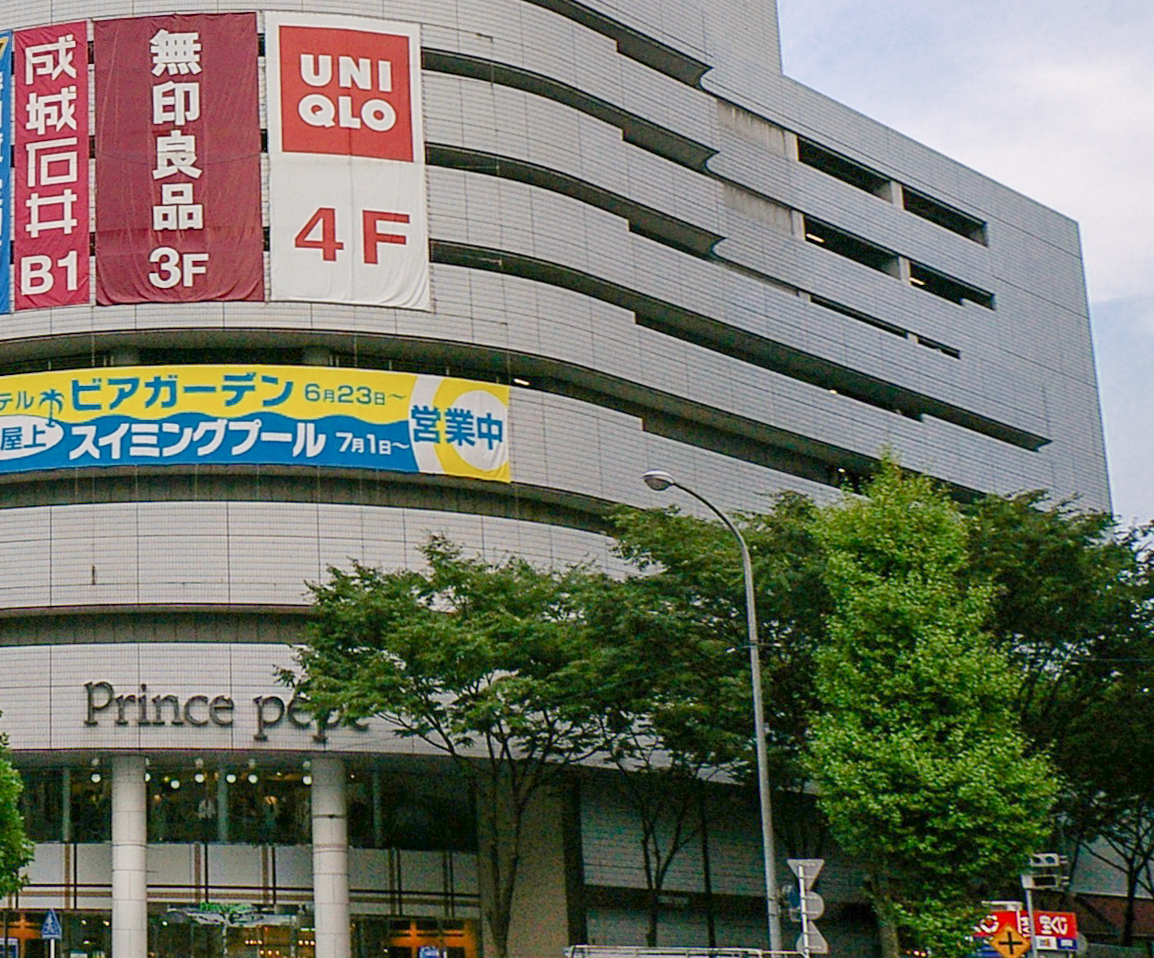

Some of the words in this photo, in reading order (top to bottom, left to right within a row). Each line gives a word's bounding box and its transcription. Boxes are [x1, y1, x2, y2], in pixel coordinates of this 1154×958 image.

[299, 52, 393, 93] UNI
[24, 33, 79, 239] 成城石井
[148, 28, 204, 232] 無印良品
[297, 93, 397, 133] QLO
[293, 207, 411, 266] 4F
[20, 250, 79, 296] B1
[148, 247, 209, 289] 3F
[70, 370, 295, 411] ビアガーデン
[68, 416, 327, 461] スイミングプール
[410, 403, 504, 453] 営業中
[83, 680, 235, 727] Prince
